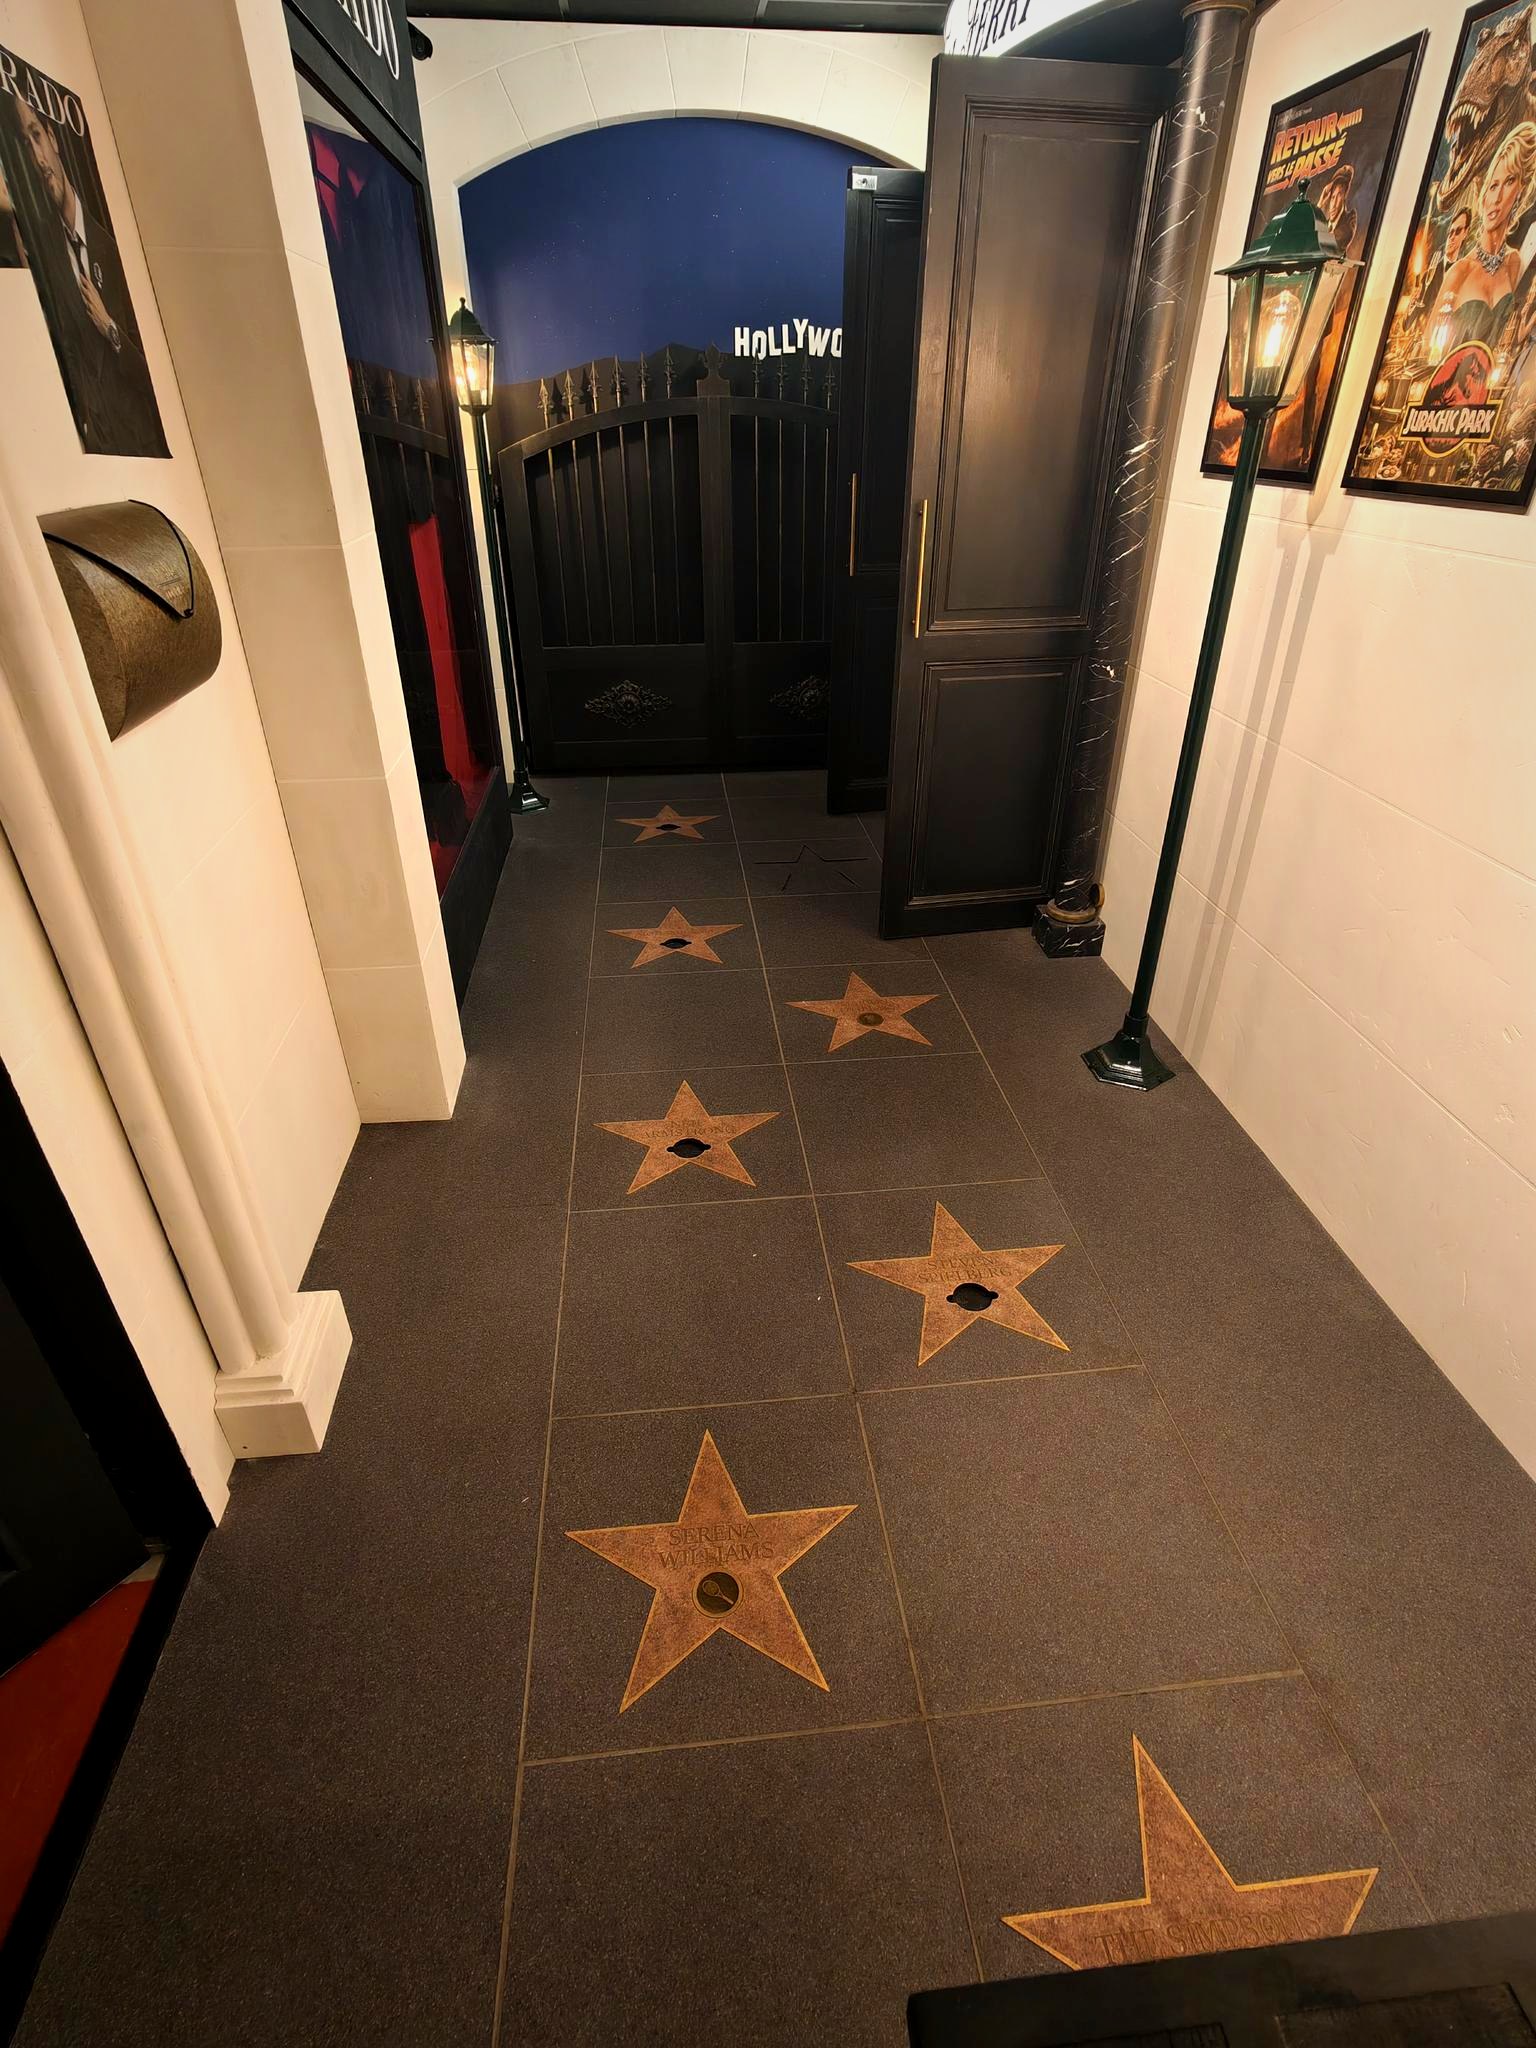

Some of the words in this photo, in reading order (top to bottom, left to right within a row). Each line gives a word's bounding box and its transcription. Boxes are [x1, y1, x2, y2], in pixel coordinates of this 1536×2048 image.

[0, 50, 84, 137] RADO
[1270, 112, 1338, 165] RETOUR
[1266, 165, 1286, 185] VERS
[1284, 160, 1296, 178] LE
[1290, 132, 1347, 186] PASSÉ
[734, 318, 842, 360] HOLLYWO
[1455, 407, 1495, 435] PARK
[643, 1124, 738, 1139] ARMSTRONG
[917, 1266, 1012, 1284] SPIELBERG
[926, 1254, 995, 1271] STEVEN
[669, 1521, 760, 1546] SERENA
[657, 1541, 774, 1570] WILLIAMS
